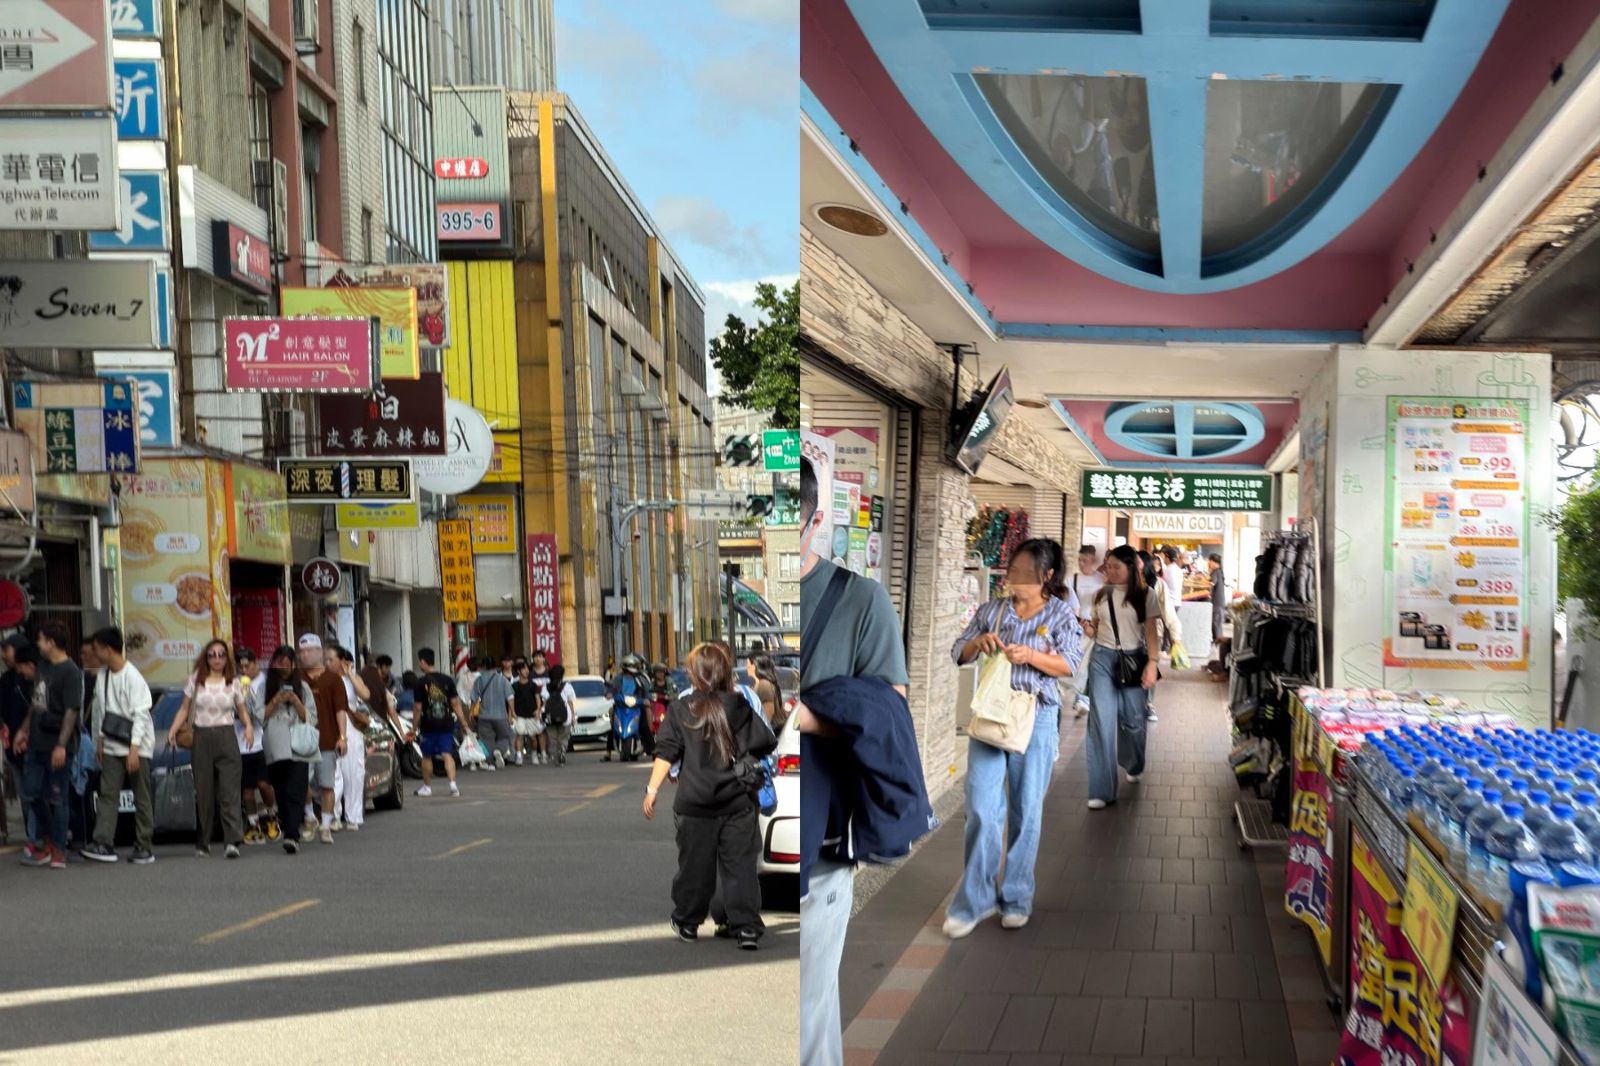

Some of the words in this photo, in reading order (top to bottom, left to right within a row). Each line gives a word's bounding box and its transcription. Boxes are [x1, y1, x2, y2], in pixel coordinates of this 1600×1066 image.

[42, 186, 100, 201] Telecom
[283, 351, 310, 361] HAIR
[313, 351, 350, 361] SALON
[326, 426, 440, 449] 皮蛋麻辣麵
[1134, 515, 1185, 529] TAIWAN
[1190, 516, 1223, 530] GOLD
[532, 542, 556, 654] 高點研究所
